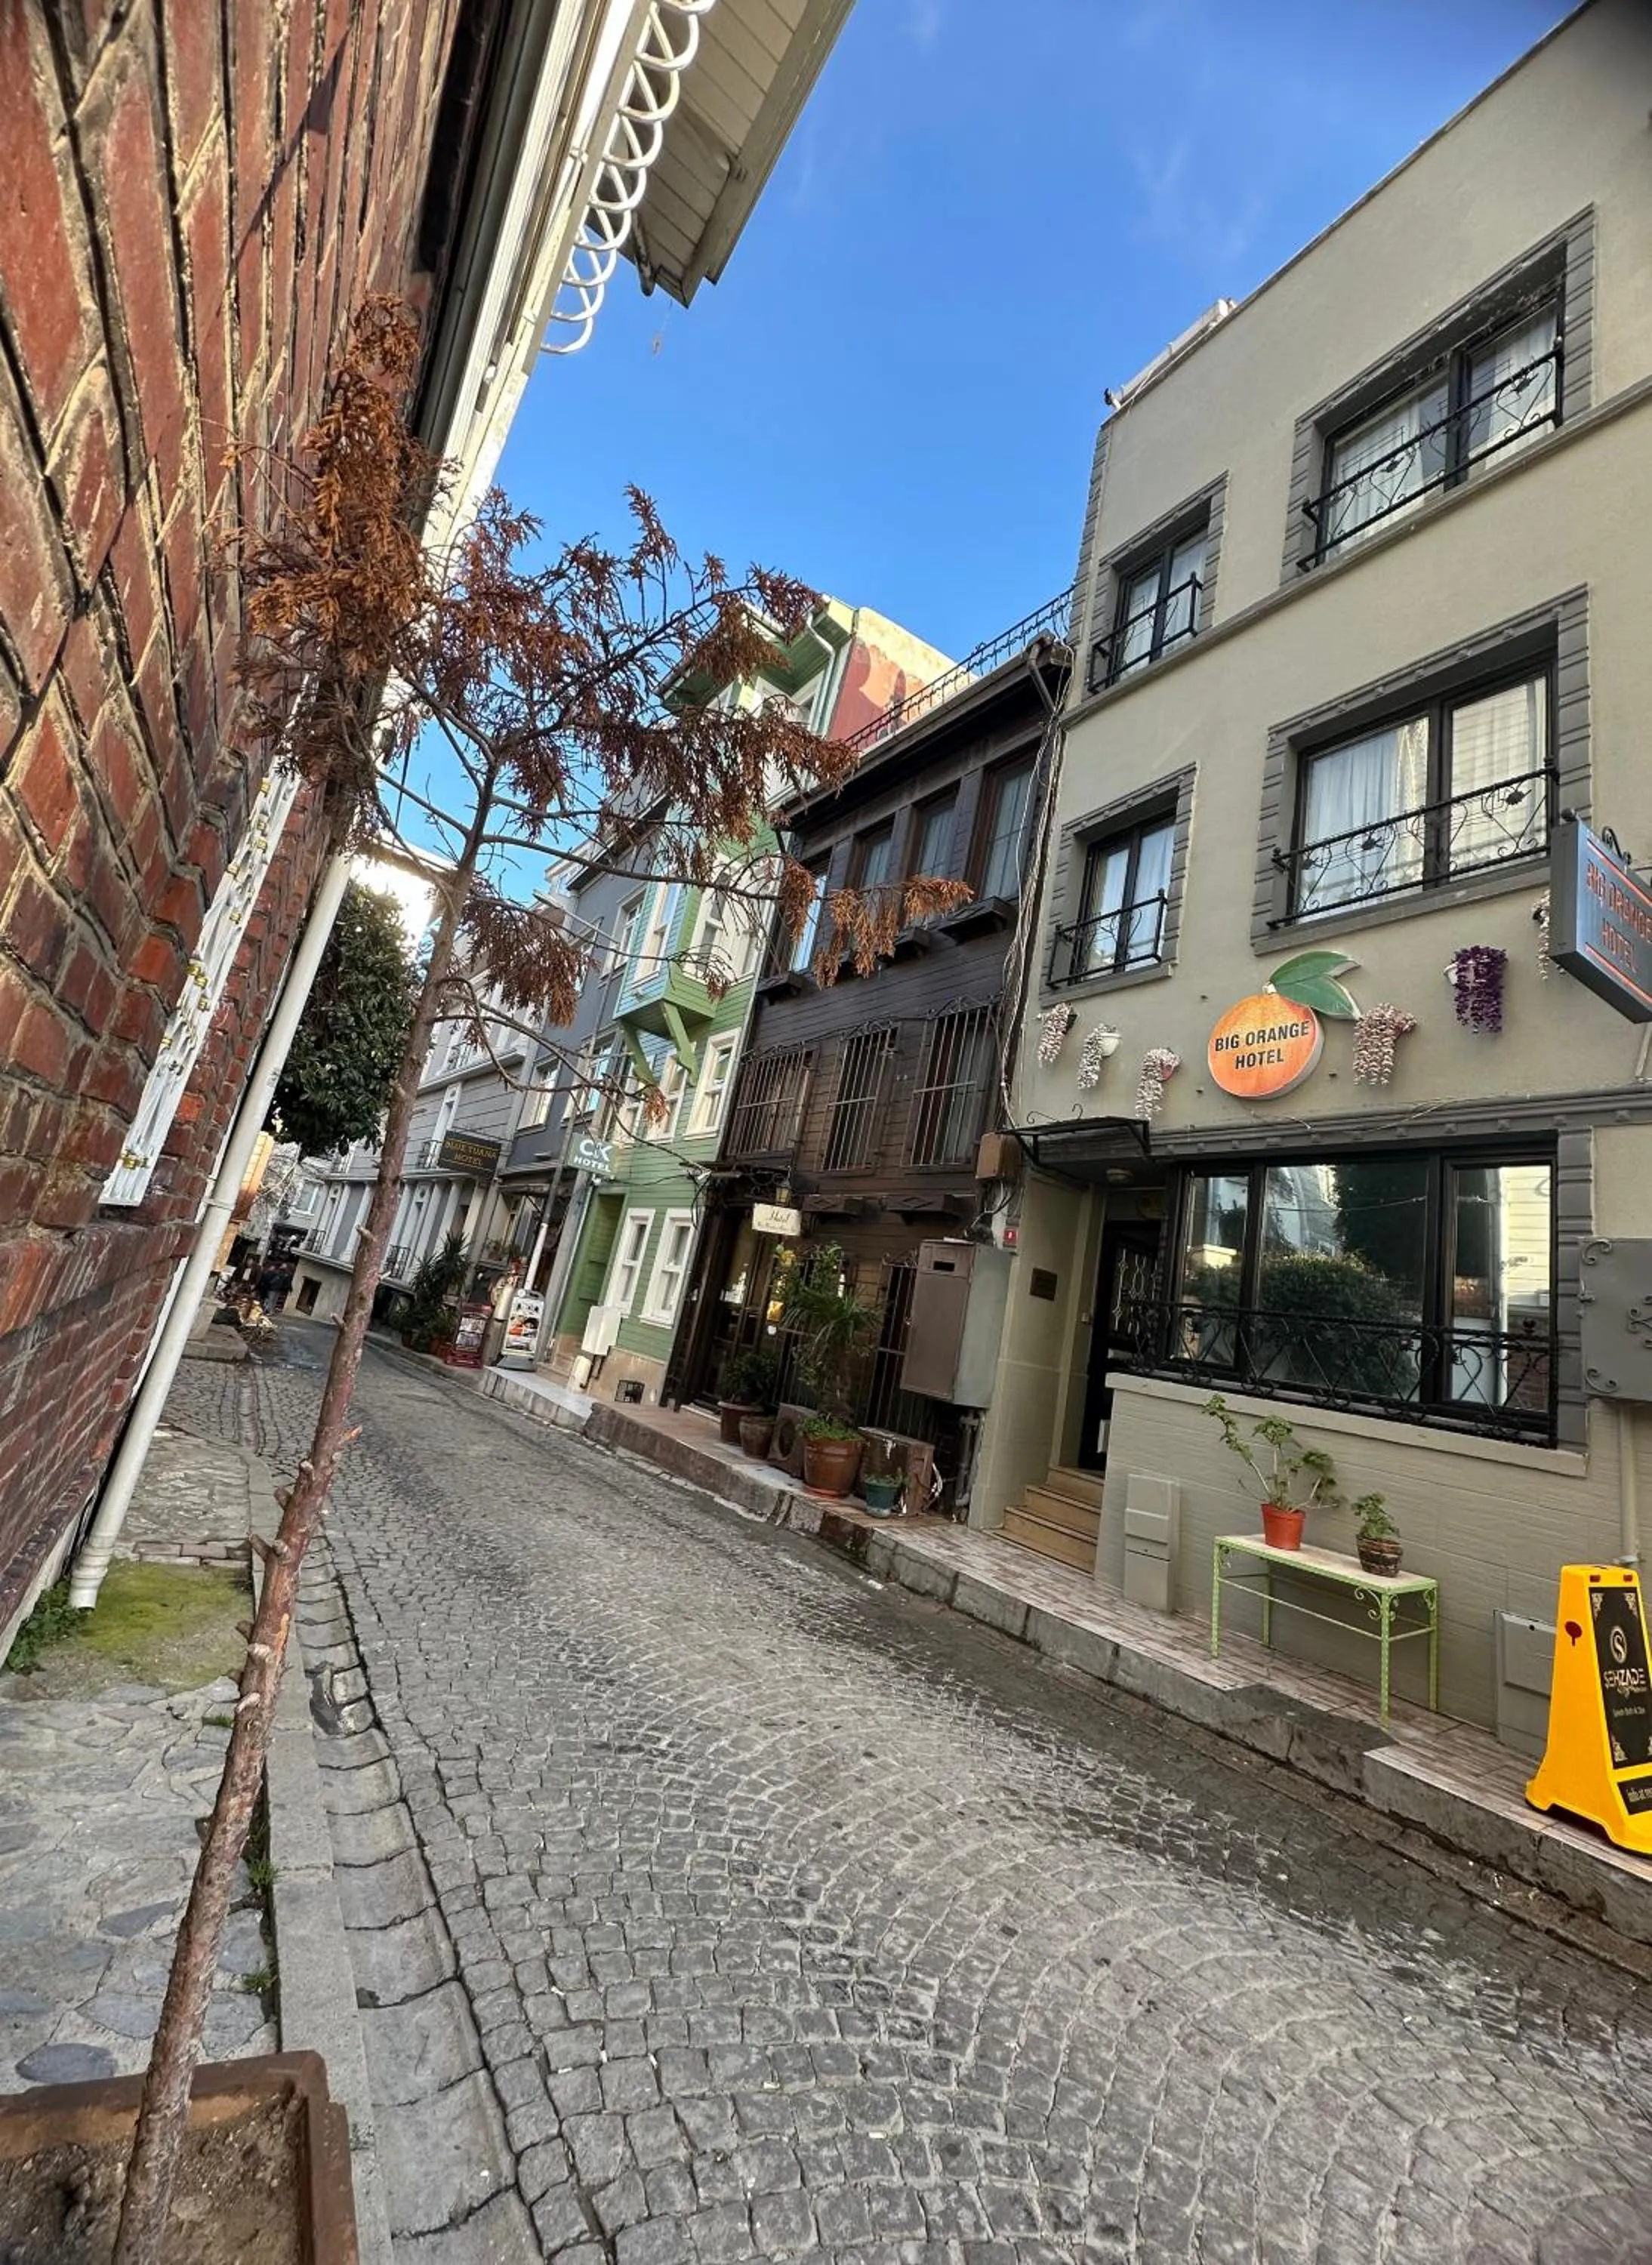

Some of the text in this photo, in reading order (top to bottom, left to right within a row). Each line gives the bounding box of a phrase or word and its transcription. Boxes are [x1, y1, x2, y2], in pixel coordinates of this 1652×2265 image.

[1601, 917, 1638, 974] HOTEL
[1215, 1020, 1310, 1052] BIG ORANGE
[1234, 1048, 1284, 1070] HOTEL
[455, 1151, 484, 1166] HOTEL
[574, 1155, 611, 1173] HOTEL
